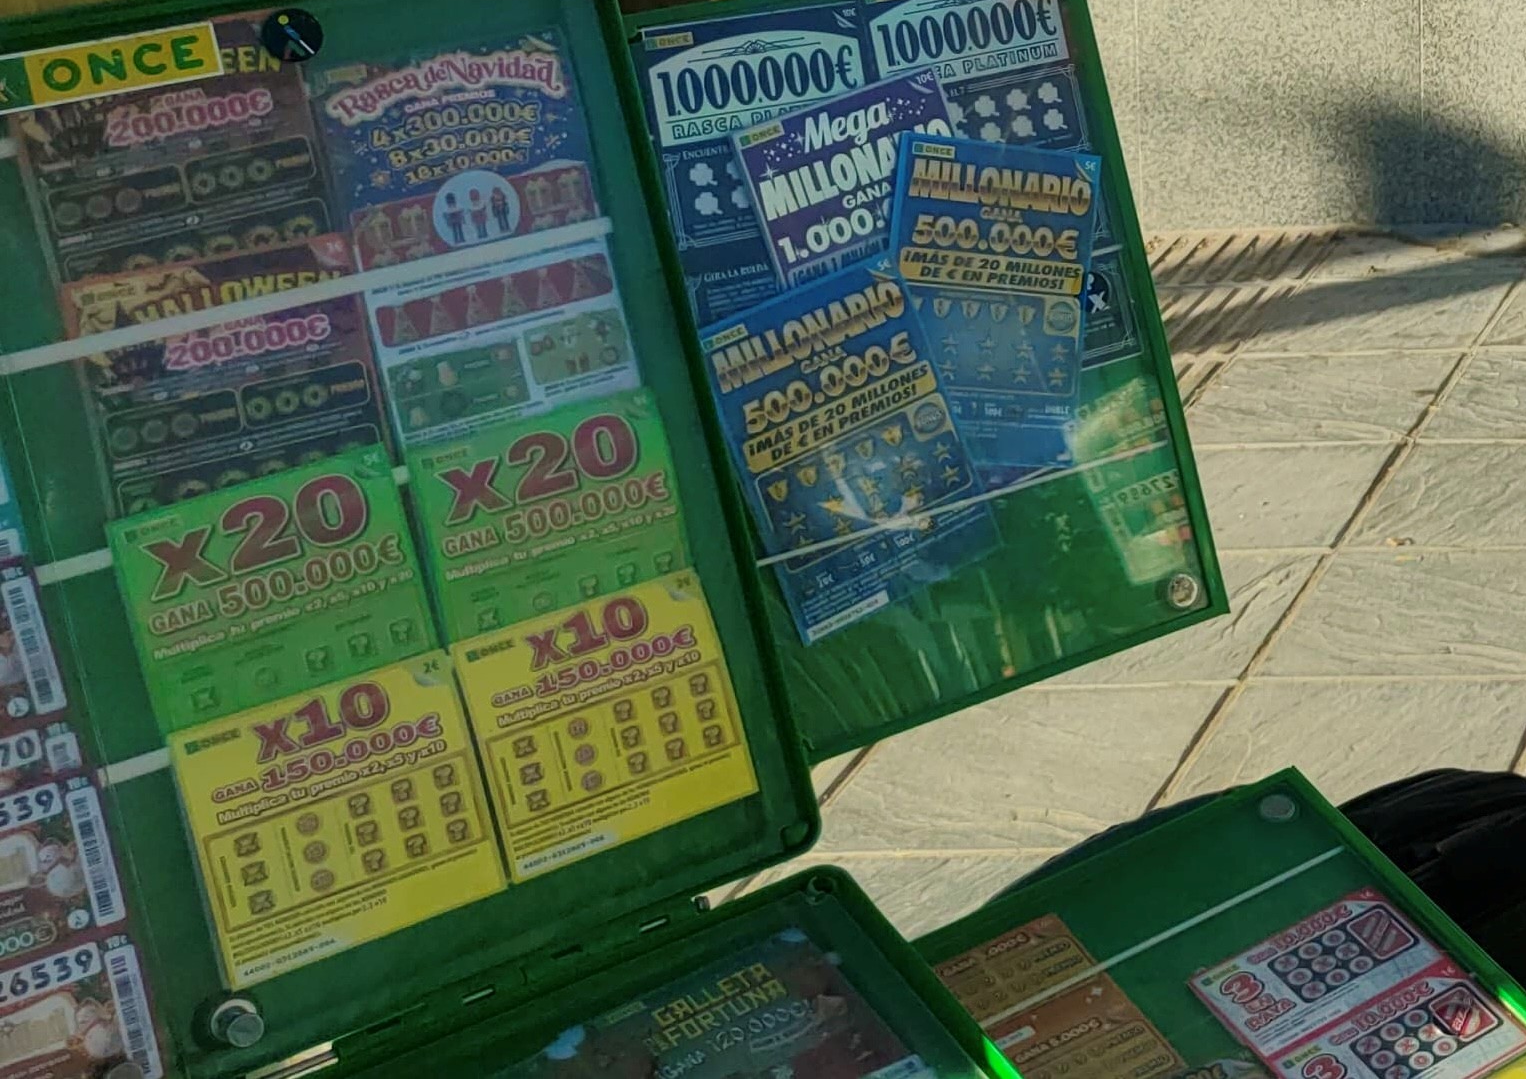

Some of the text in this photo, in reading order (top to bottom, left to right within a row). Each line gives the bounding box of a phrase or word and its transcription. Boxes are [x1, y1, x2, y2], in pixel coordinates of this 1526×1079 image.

[42, 35, 204, 92] ONCE
[963, 42, 1058, 75] PLATINUM
[331, 53, 563, 121] Rasca de Navidad
[108, 89, 274, 147] 200.000€
[672, 114, 743, 139] RASCA
[804, 101, 891, 153] Mega
[925, 144, 953, 157] ONCE
[843, 181, 892, 209] GANA
[908, 158, 1092, 217] MILLONARIO
[911, 214, 1080, 260] 500.000€
[920, 266, 944, 279] DE
[961, 270, 983, 282] EN
[986, 272, 1065, 291] PREMIOS!
[953, 256, 976, 269] DE
[979, 257, 1001, 270] 20
[1005, 260, 1081, 280] MILLONES
[166, 314, 331, 369] 200.000€
[711, 280, 905, 394] MILLONARIO
[743, 331, 917, 434] 500.000€
[798, 415, 819, 433] DE
[824, 402, 847, 422] 20
[852, 363, 930, 408] MILLONES
[770, 440, 794, 462] DE
[812, 421, 835, 439] EN
[838, 386, 917, 427] PREMIOS!
[443, 471, 670, 559] GANA 500.000€
[150, 532, 405, 635] GANA 500.000€
[152, 626, 226, 661] Multiplica
[422, 661, 440, 674] 2€
[536, 623, 698, 698] 150.000€
[498, 701, 558, 728] Multiplica
[562, 695, 576, 707] tu
[579, 677, 622, 701] premio
[261, 712, 442, 793] 150.000€
[217, 793, 288, 826] Multiplica
[290, 786, 307, 801] tu
[310, 772, 358, 798] premio
[1220, 971, 1265, 1004] 3
